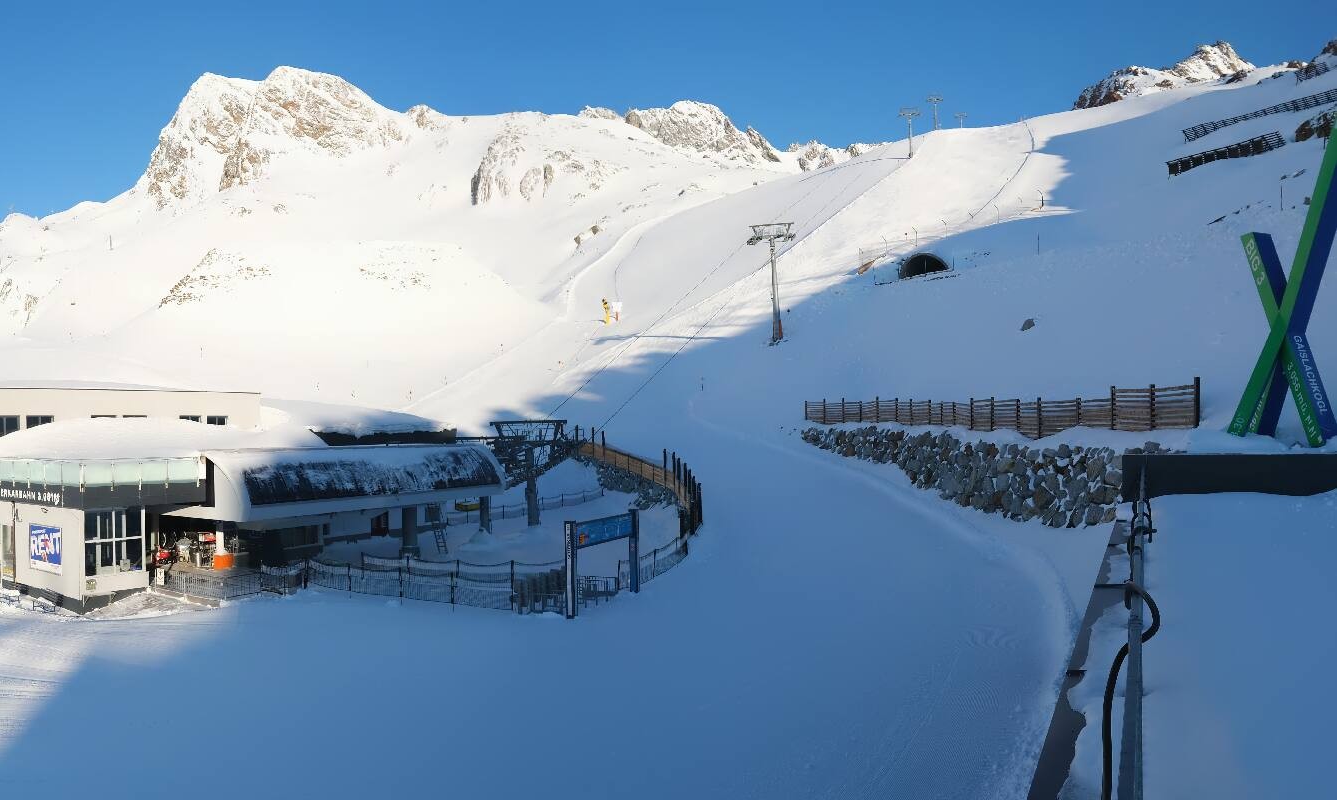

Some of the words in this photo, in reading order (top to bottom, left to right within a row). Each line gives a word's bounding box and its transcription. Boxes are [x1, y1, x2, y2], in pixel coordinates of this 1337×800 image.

[1246, 239, 1261, 271] BIG
[1256, 272, 1266, 286] 3
[1293, 335, 1328, 413] GAISLACHKOGL
[30, 532, 61, 557] RENT
